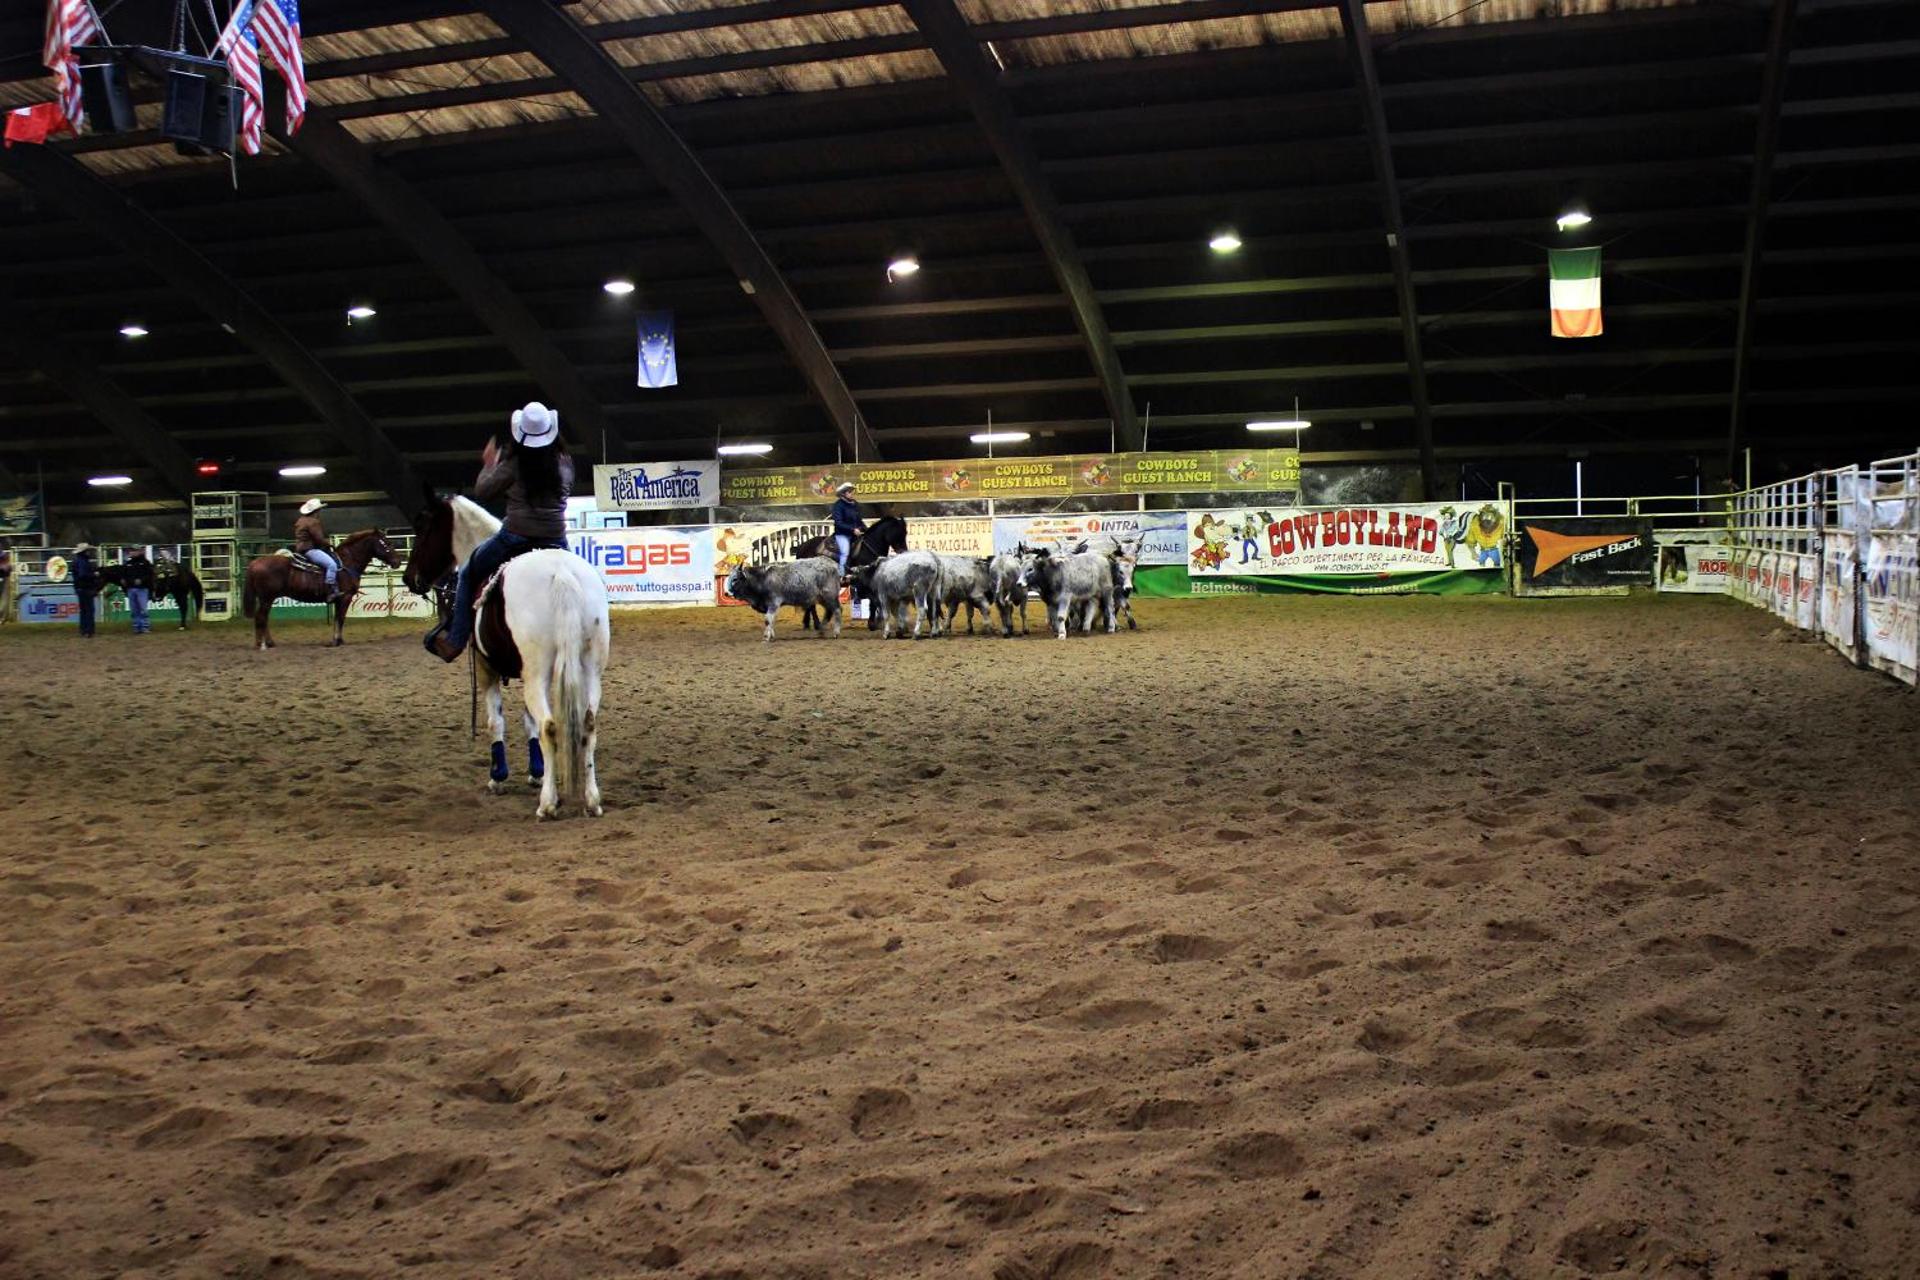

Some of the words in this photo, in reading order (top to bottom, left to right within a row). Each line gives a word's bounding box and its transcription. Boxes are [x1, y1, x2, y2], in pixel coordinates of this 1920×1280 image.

[995, 463, 1054, 476] COWBOYS
[1137, 459, 1198, 471] COWBOYS
[859, 469, 915, 481] COWBOYS
[1123, 472, 1164, 484] GUEST
[1167, 471, 1212, 483] RANCH
[642, 474, 700, 501] America
[731, 476, 784, 488] COWBOYS
[887, 480, 929, 493] RANCH
[982, 477, 1021, 489] GUEST
[1024, 475, 1068, 487] RANCH
[757, 486, 798, 498] RANCH
[1101, 520, 1139, 532] INTRA
[1268, 509, 1438, 558] COWBOYLAND
[926, 539, 981, 552] FAMIGLIA
[1571, 548, 1604, 565] Fast
[1608, 537, 1642, 555] Back
[606, 580, 713, 594] www.tuttogasspa.it
[1191, 581, 1257, 594] Heineken
[28, 600, 80, 618] ultraga
